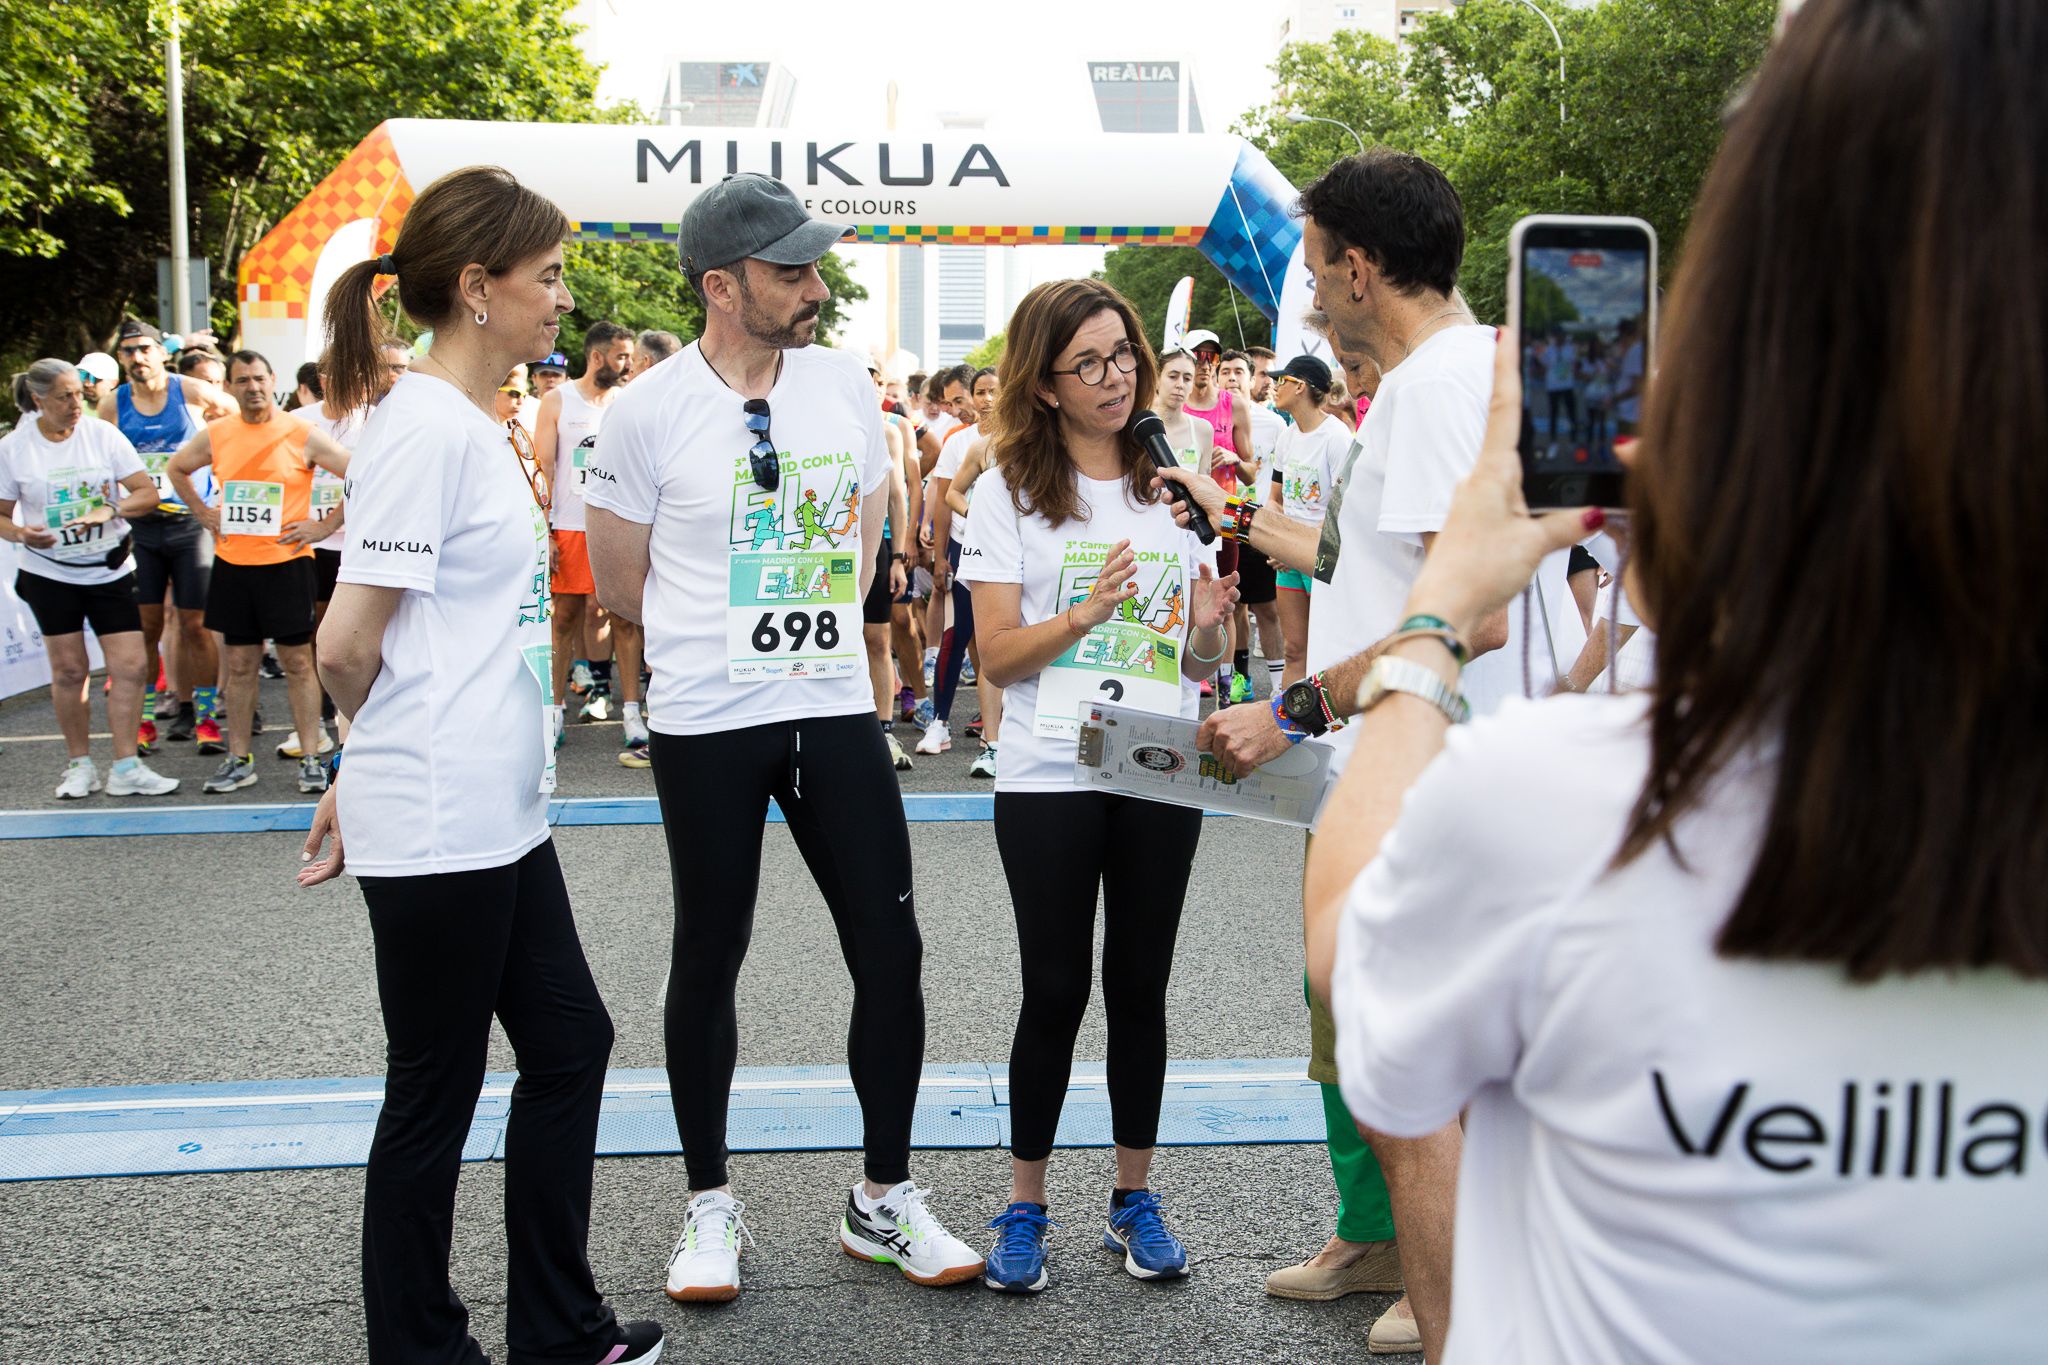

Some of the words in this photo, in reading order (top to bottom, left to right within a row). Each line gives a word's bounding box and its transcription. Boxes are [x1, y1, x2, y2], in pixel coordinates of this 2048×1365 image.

[637, 139, 1011, 187] MUKUA
[821, 199, 917, 215] COLOURS
[802, 454, 833, 470] CON
[836, 452, 853, 463] LA
[232, 486, 268, 502] ELA
[228, 506, 272, 523] 1154
[363, 539, 434, 554] MUKUA
[1080, 541, 1113, 550] Carrer
[762, 556, 796, 565] MADRID
[798, 556, 813, 564] CON
[815, 556, 825, 564] LA
[1163, 553, 1180, 563] LA
[756, 565, 831, 600] ELA
[751, 610, 840, 653] 698
[1120, 629, 1140, 637] CON
[1141, 632, 1151, 640] LA
[1073, 634, 1155, 673] ELA
[1651, 1069, 2048, 1178] Velilla
